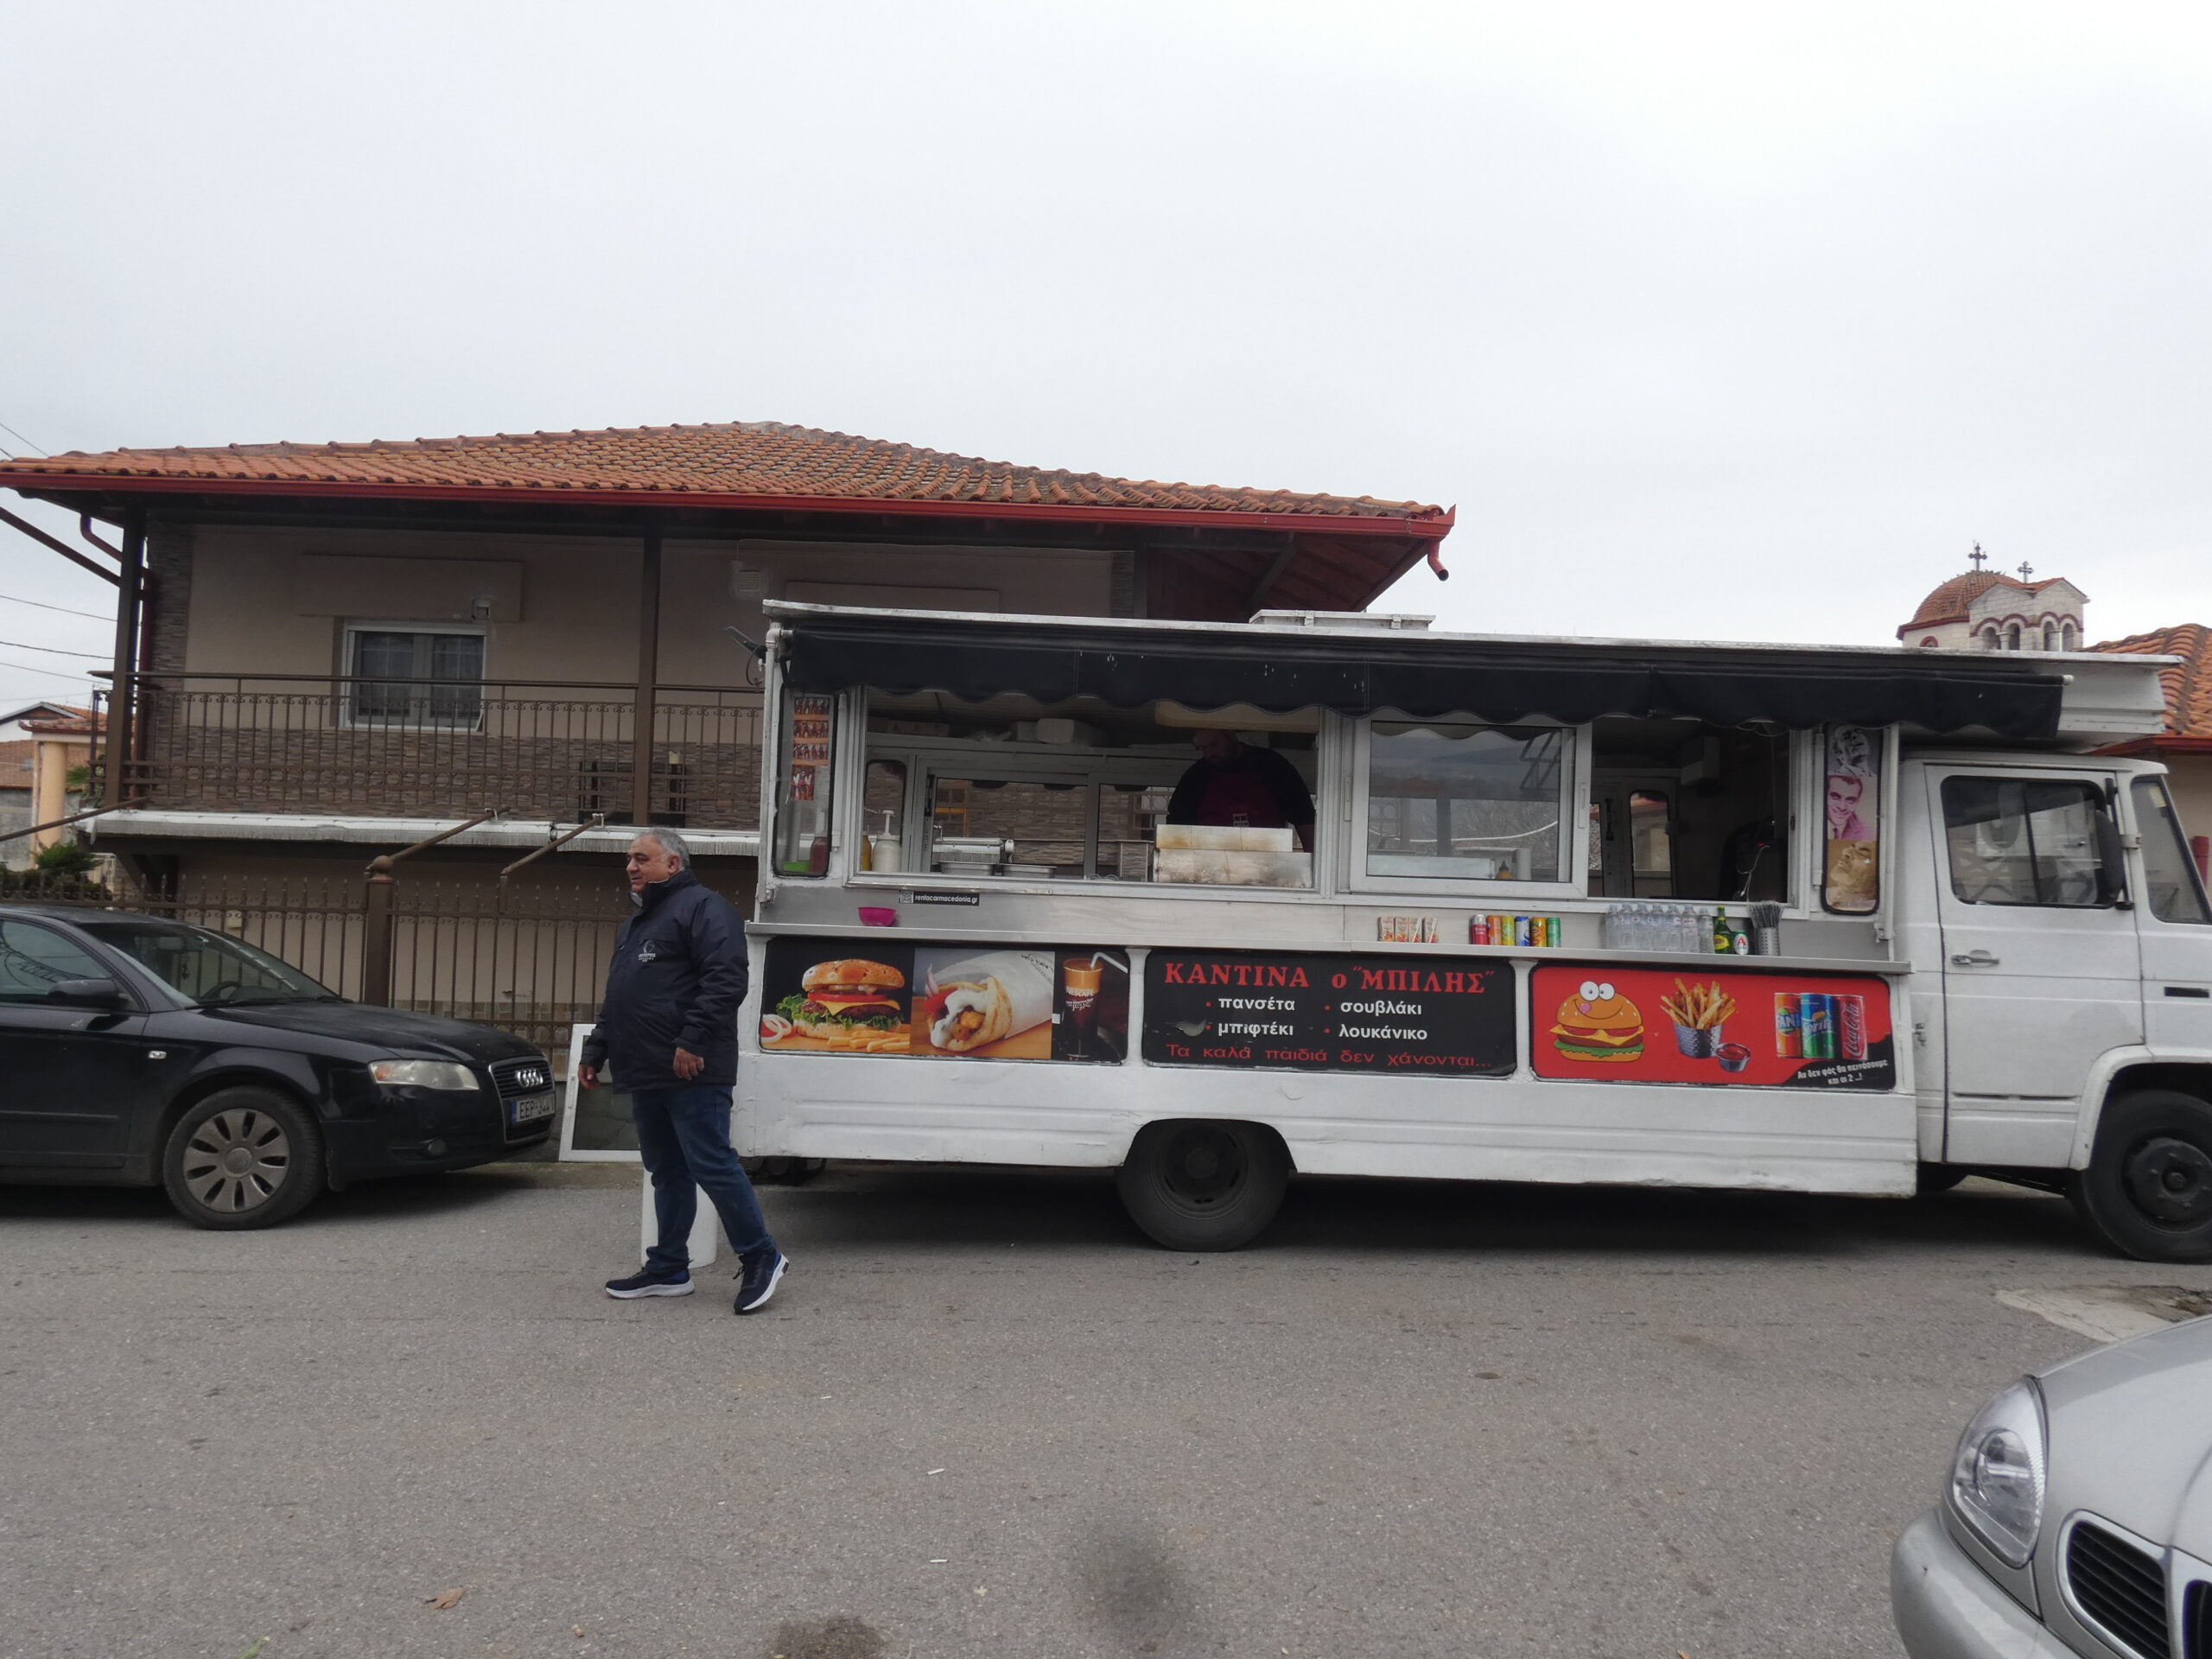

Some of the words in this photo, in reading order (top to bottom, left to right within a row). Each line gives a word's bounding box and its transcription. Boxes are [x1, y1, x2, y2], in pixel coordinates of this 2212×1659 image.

[915, 893, 977, 904] rentacarmacedonia.gr
[1164, 963, 1310, 988] ΚΑΝΤΙΝΑ
[1332, 973, 1347, 988] ο
[1218, 996, 1295, 1011] πανσέτα
[1340, 1000, 1422, 1016] σουβλάκι
[1218, 1021, 1294, 1038] μπιφτέκι
[1338, 1024, 1428, 1040] λουκάνικο
[1166, 1044, 1190, 1057] Τα
[1203, 1046, 1251, 1059] καλά
[1265, 1049, 1328, 1062] παιδιά
[1340, 1050, 1376, 1064] δεν
[1808, 1069, 1821, 1077] δεν
